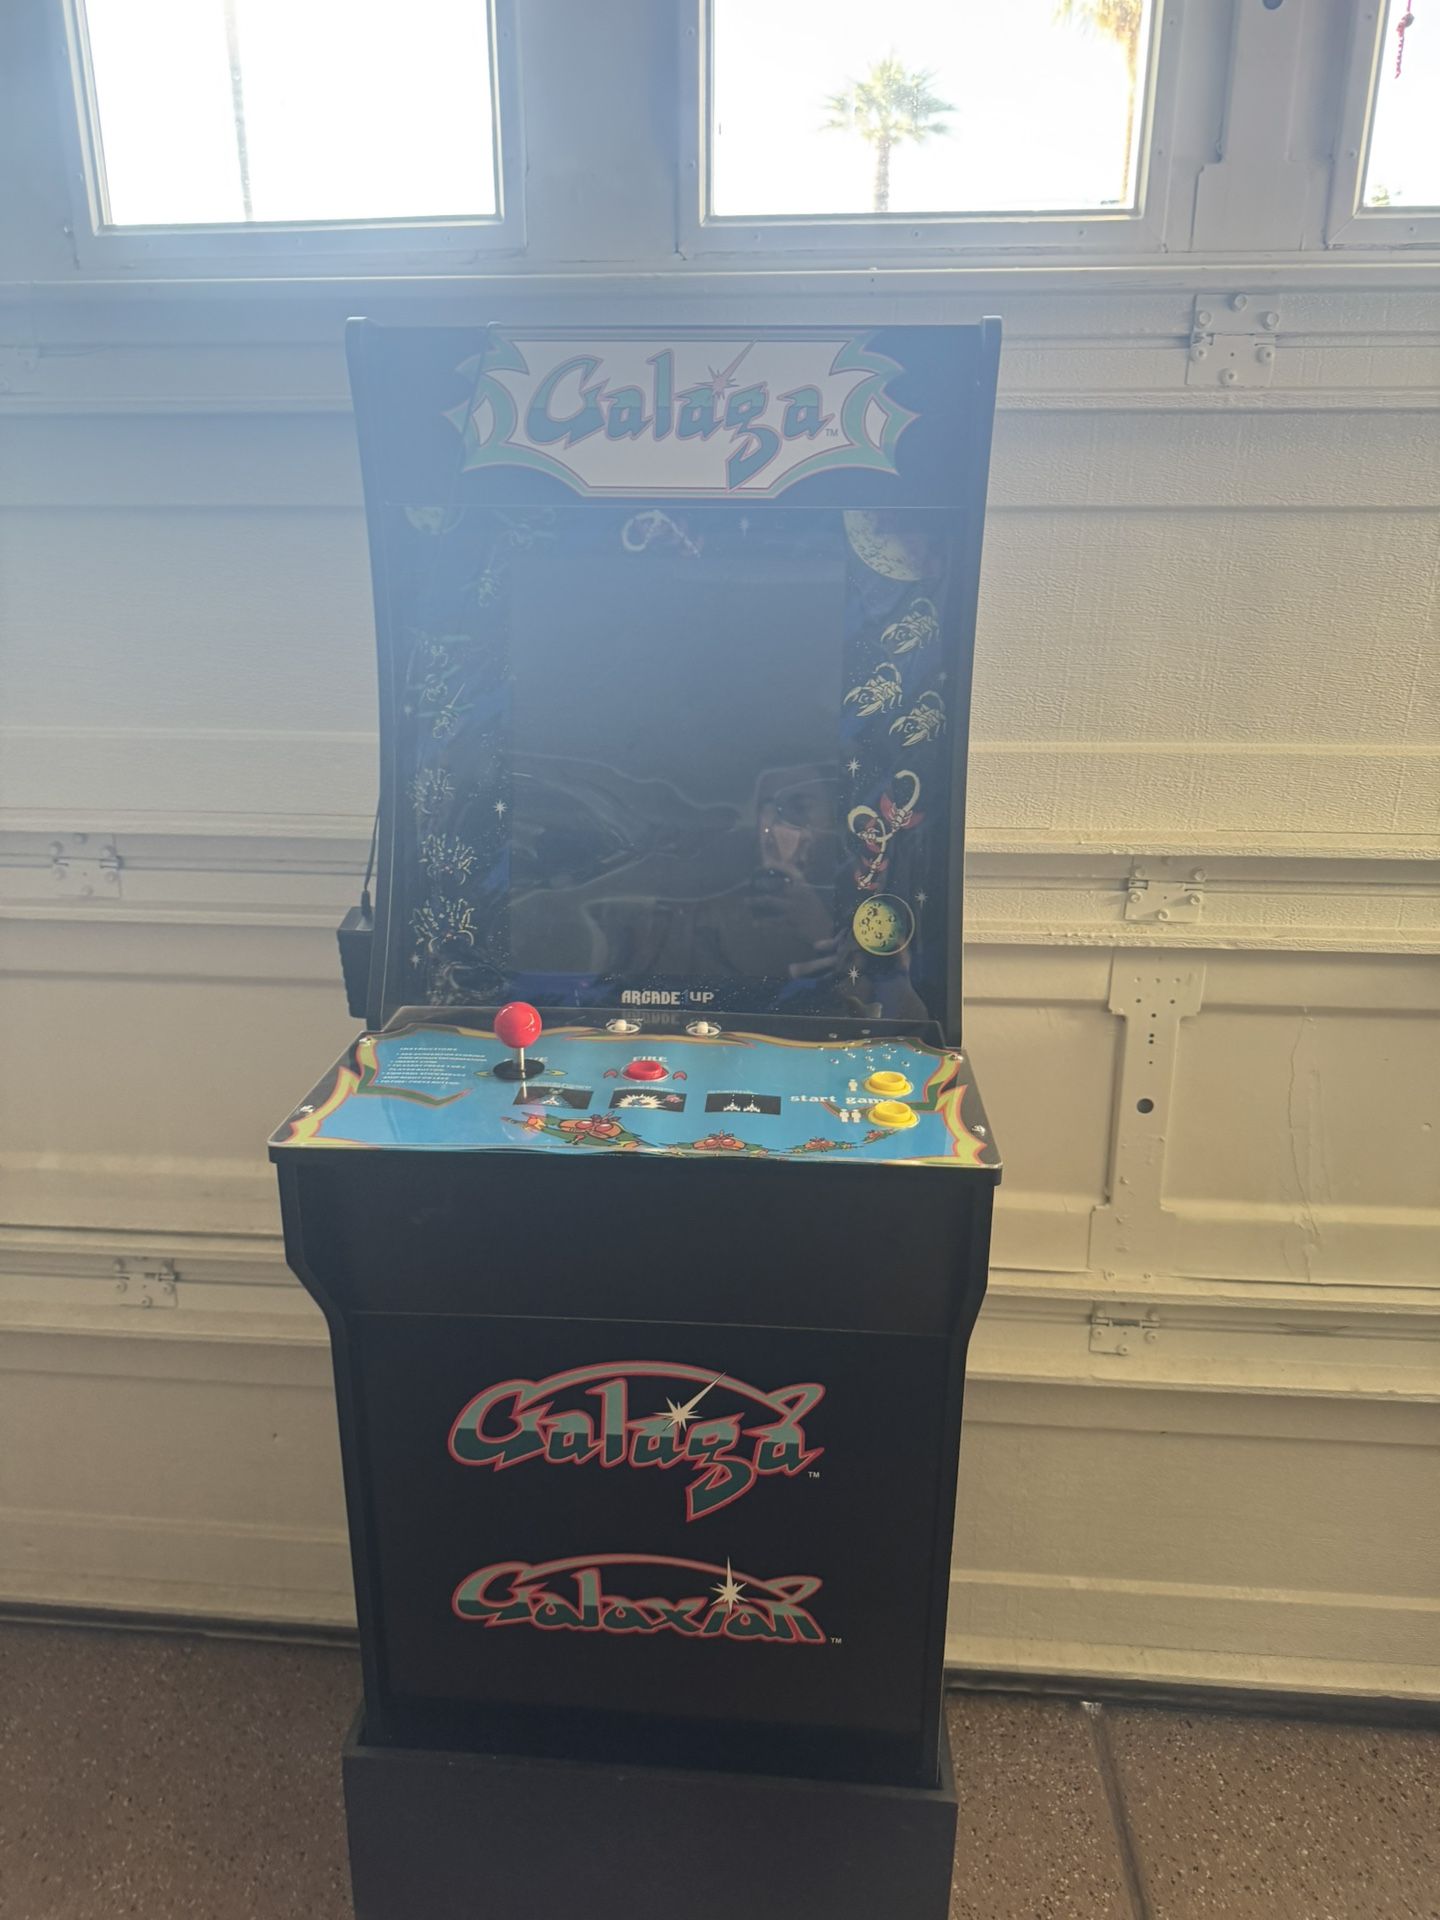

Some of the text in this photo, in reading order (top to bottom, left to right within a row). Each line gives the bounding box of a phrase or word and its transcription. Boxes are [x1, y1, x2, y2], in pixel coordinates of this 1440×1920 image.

[525, 348, 834, 494] Galaga
[621, 990, 681, 1006] ARCADE
[790, 1095, 837, 1103] start
[448, 1360, 826, 1522] Galaga
[452, 1553, 826, 1643] Galaxian
